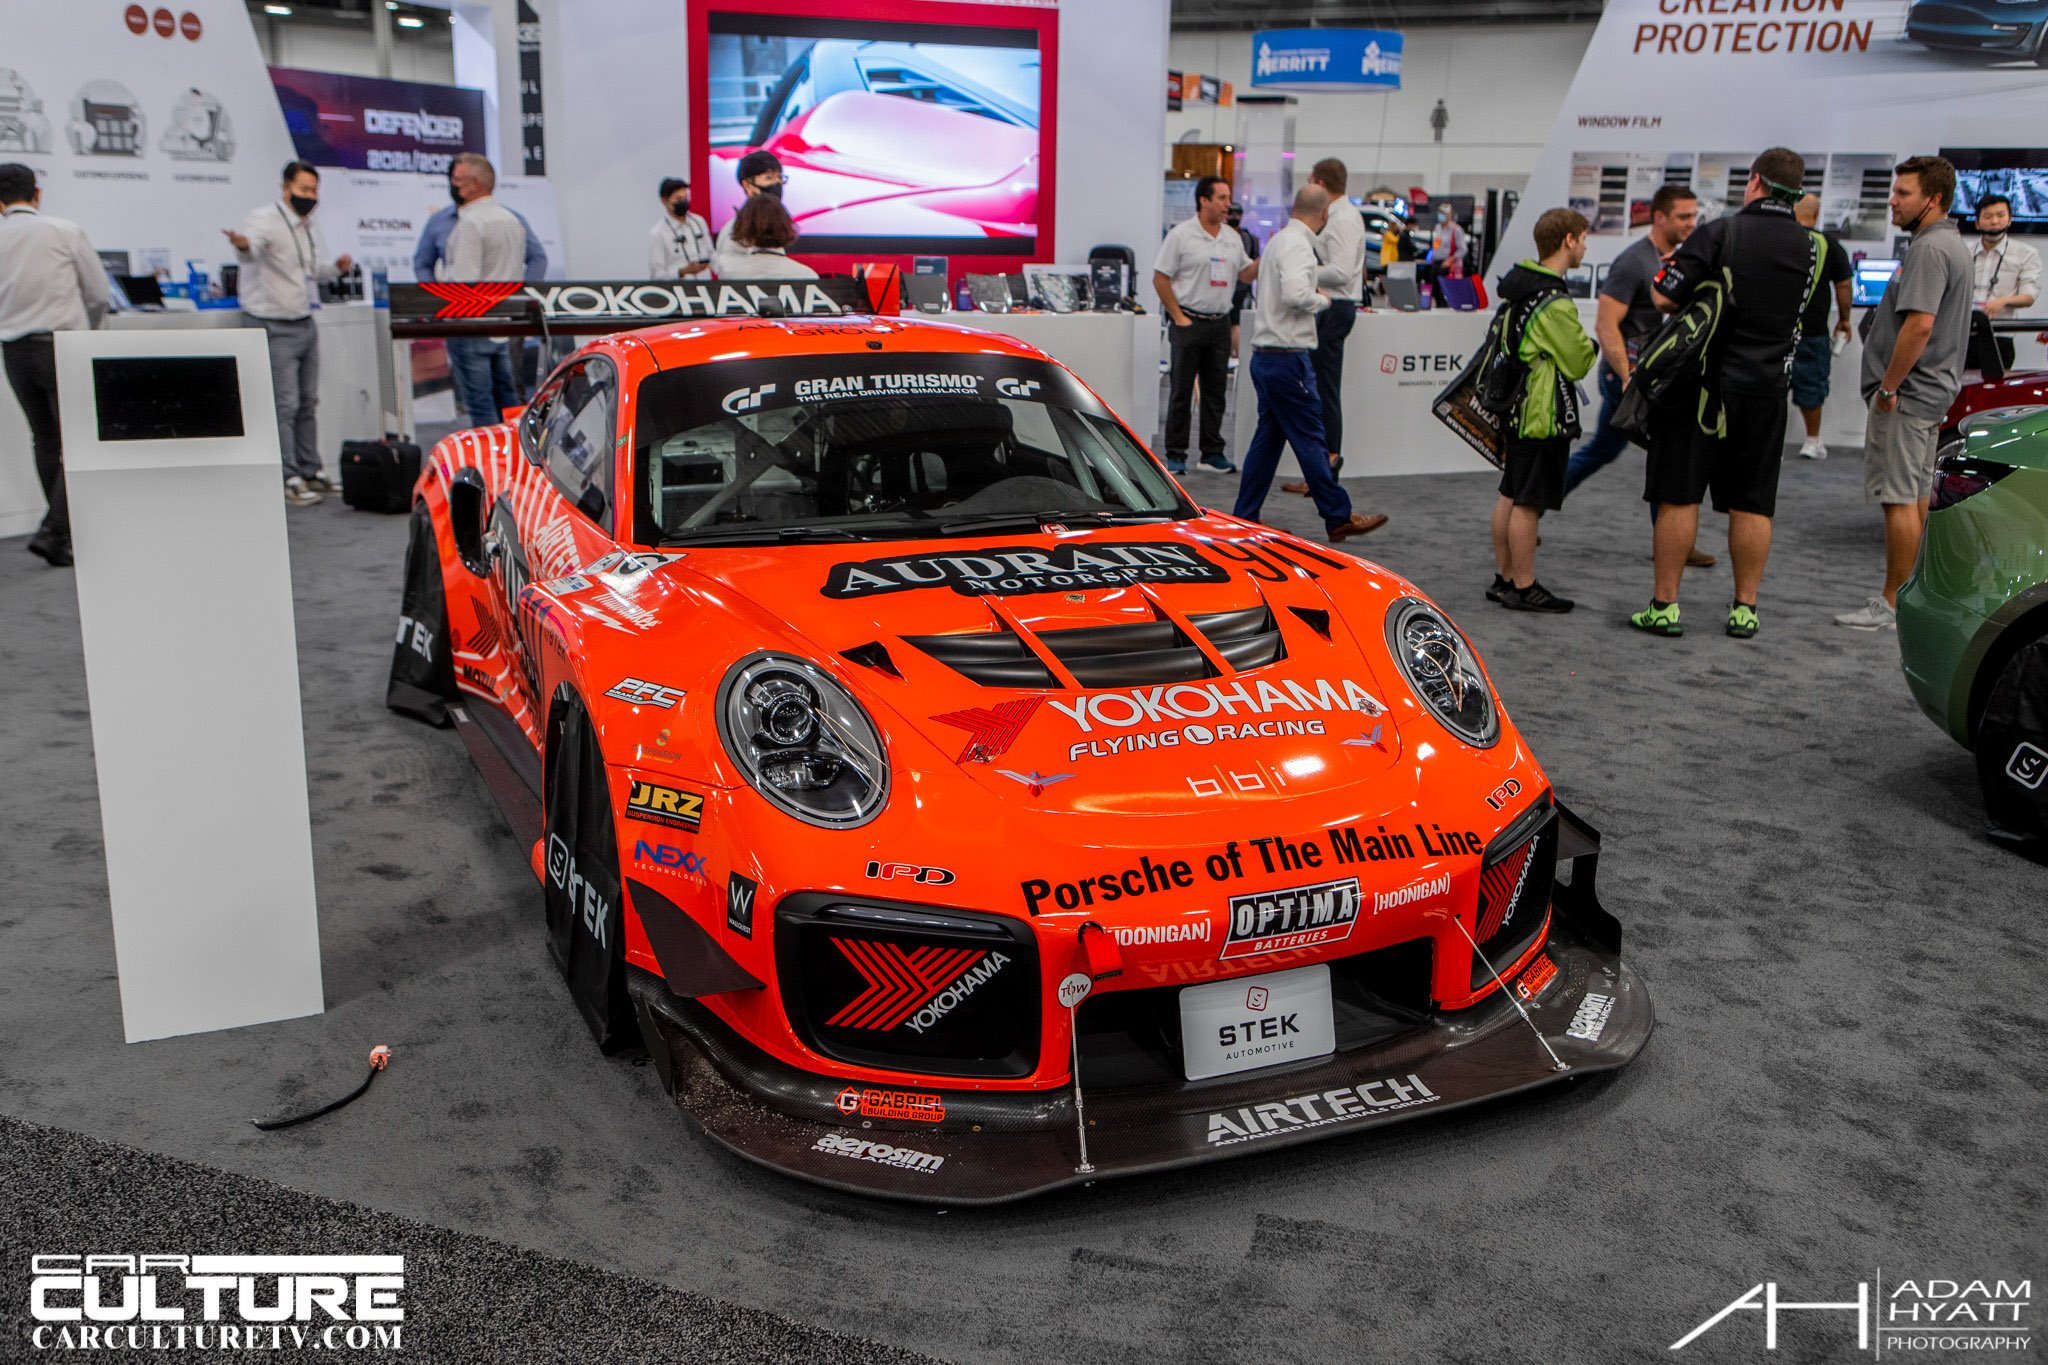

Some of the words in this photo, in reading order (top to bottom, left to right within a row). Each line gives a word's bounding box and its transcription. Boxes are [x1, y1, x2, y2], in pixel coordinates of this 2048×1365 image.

[1633, 20, 1873, 54] PROTECTION
[1257, 55, 1330, 77] MERRITT
[364, 108, 463, 141] DEFENDER
[1577, 116, 1629, 129] WINDOW
[1631, 115, 1662, 128] FILM
[523, 284, 841, 318] YOKOHAMA
[1402, 354, 1462, 371] STEK
[794, 376, 864, 395] GRAN
[870, 374, 977, 389] TURISMO
[796, 395, 822, 403] THE
[824, 392, 858, 401] REAL
[859, 388, 908, 398] DRIVING
[911, 386, 978, 396] SIMULATOR
[840, 546, 1199, 592] AUDRAIN
[1200, 538, 1348, 582] 911
[967, 566, 1213, 591] MOTORSPORT
[613, 677, 687, 706] PFC
[1045, 679, 1387, 732] YOKOHAMA
[1068, 729, 1180, 762] FLYING
[1217, 719, 1326, 740] RACING
[630, 783, 703, 818] JRZ
[1485, 778, 1522, 812] IPD
[627, 810, 665, 823] SUSPENSION
[634, 840, 706, 877] NEXX
[865, 860, 956, 886] IPD
[1020, 852, 1195, 917] Porsche
[1205, 842, 1243, 883] of
[1248, 836, 1323, 875] The
[1332, 826, 1416, 865] Main
[1417, 823, 1483, 858] Line
[1501, 835, 1540, 926] YOKOHAMA
[1236, 888, 1353, 936] OPTIMA
[1254, 930, 1328, 951] BATTERIES
[905, 950, 1012, 1035] YOKOHAMA
[1061, 980, 1088, 997] TOW
[1219, 1012, 1300, 1047] STEK
[1226, 1040, 1295, 1060] AUTOMOTIVE
[867, 1107, 909, 1119] BUILDING
[911, 1110, 943, 1121] GROUP
[869, 1091, 944, 1113] GABRIEL
[1208, 1074, 1434, 1143] AIRTECH
[1214, 1125, 1303, 1147] ADVANCED
[1304, 1106, 1389, 1129] MATERIALS
[1390, 1095, 1441, 1110] GROUP
[811, 1145, 920, 1171] RESEARCH
[817, 1133, 945, 1170] aerosim
